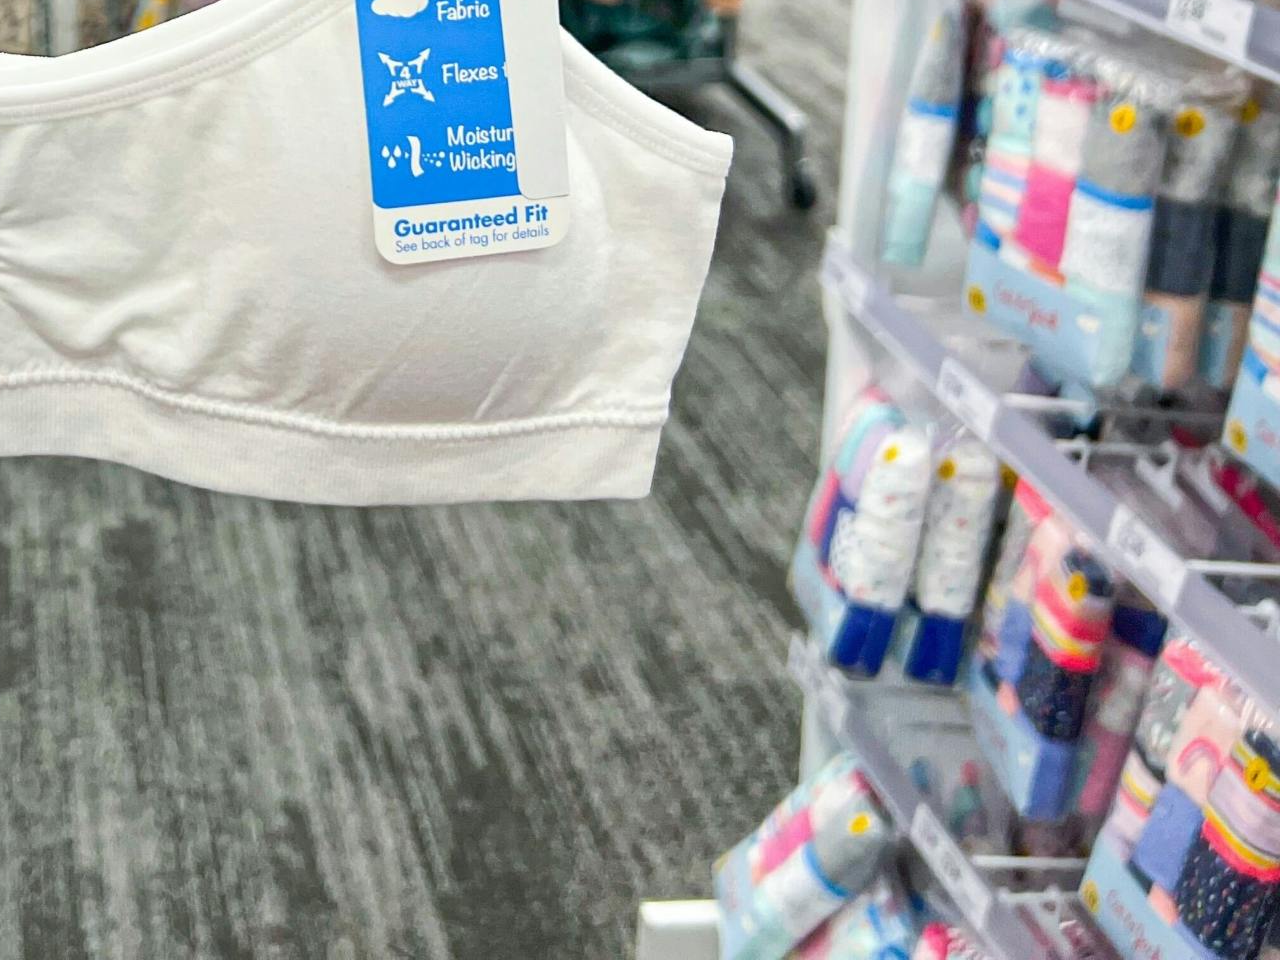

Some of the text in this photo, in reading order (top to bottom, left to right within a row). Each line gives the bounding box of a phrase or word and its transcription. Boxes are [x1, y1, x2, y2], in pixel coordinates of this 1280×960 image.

[436, 0, 490, 22] Fabric
[400, 66, 411, 80] 4
[442, 62, 498, 84] Flexes
[449, 149, 516, 172] Wicking
[394, 204, 548, 238] Guaranteed Fit
[396, 223, 550, 254] See back of tag for details
